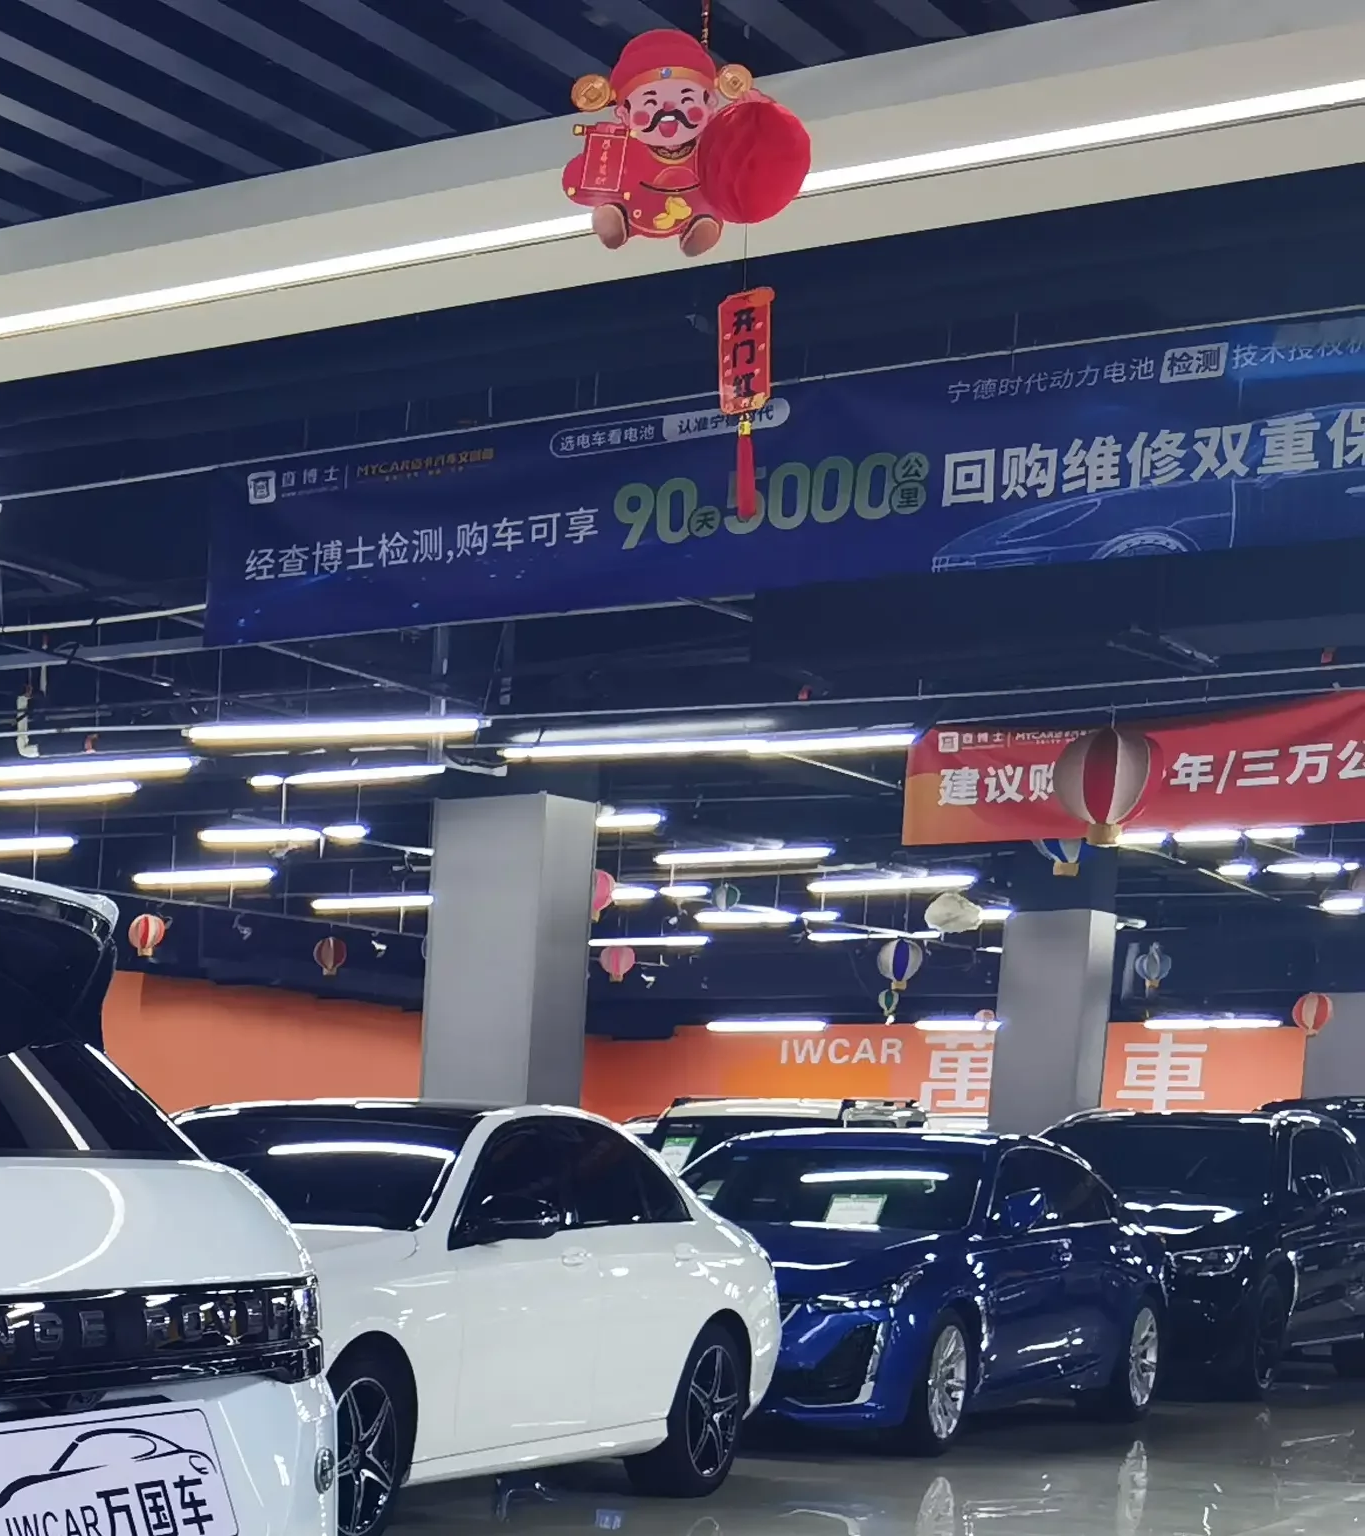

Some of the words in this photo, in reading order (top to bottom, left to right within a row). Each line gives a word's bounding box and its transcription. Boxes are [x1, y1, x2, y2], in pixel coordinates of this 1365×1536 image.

[732, 306, 757, 399] 开门红
[947, 358, 1155, 404] 宁德时代动力电池
[1167, 348, 1224, 378] 检测
[244, 507, 599, 581] 经查博士检测,购车可享
[780, 1038, 902, 1064] IWCAR
